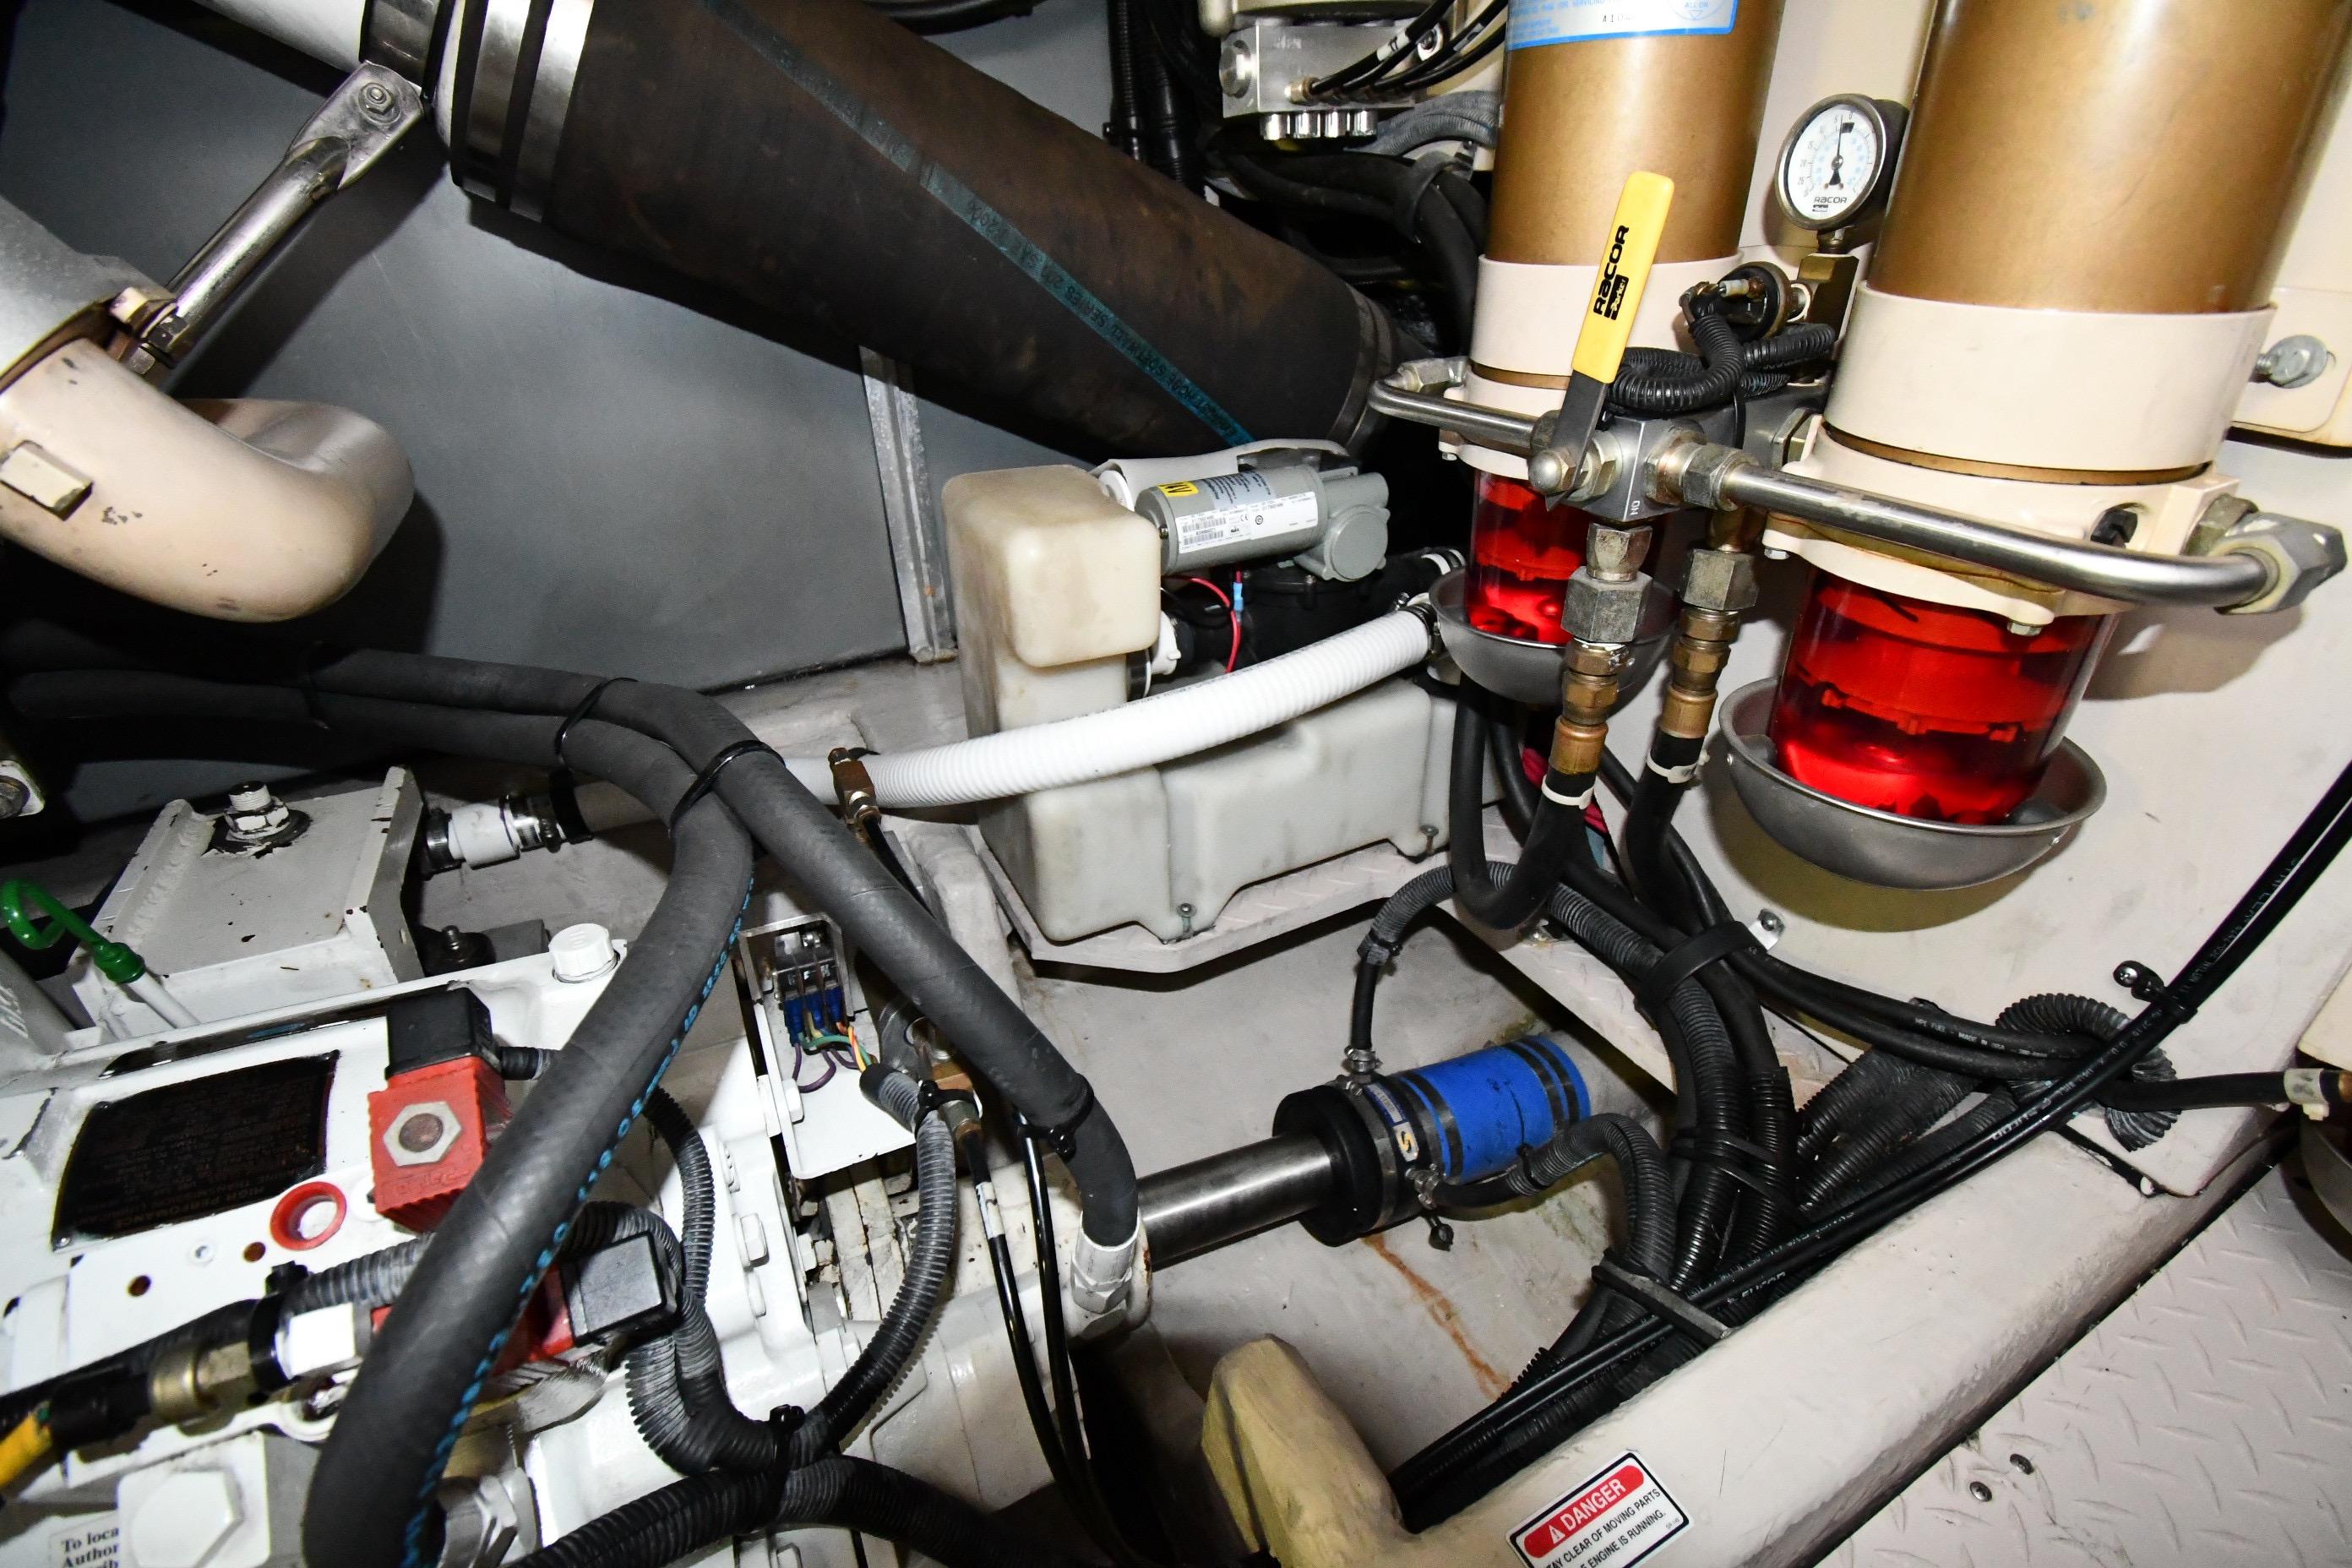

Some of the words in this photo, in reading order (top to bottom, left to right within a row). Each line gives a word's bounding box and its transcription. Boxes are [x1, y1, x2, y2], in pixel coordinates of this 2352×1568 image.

[1560, 1478, 1626, 1531] DANGER
[1564, 1538, 1592, 1563] CLEAR
[1591, 1531, 1603, 1543] OF
[1606, 1507, 1636, 1533] MOVING
[1634, 1489, 1661, 1511] PARTS
[62, 1538, 82, 1553] To
[1587, 1541, 1620, 1568] ENGINE
[1617, 1535, 1629, 1548] IS
[1629, 1509, 1666, 1540] RUNNING.
